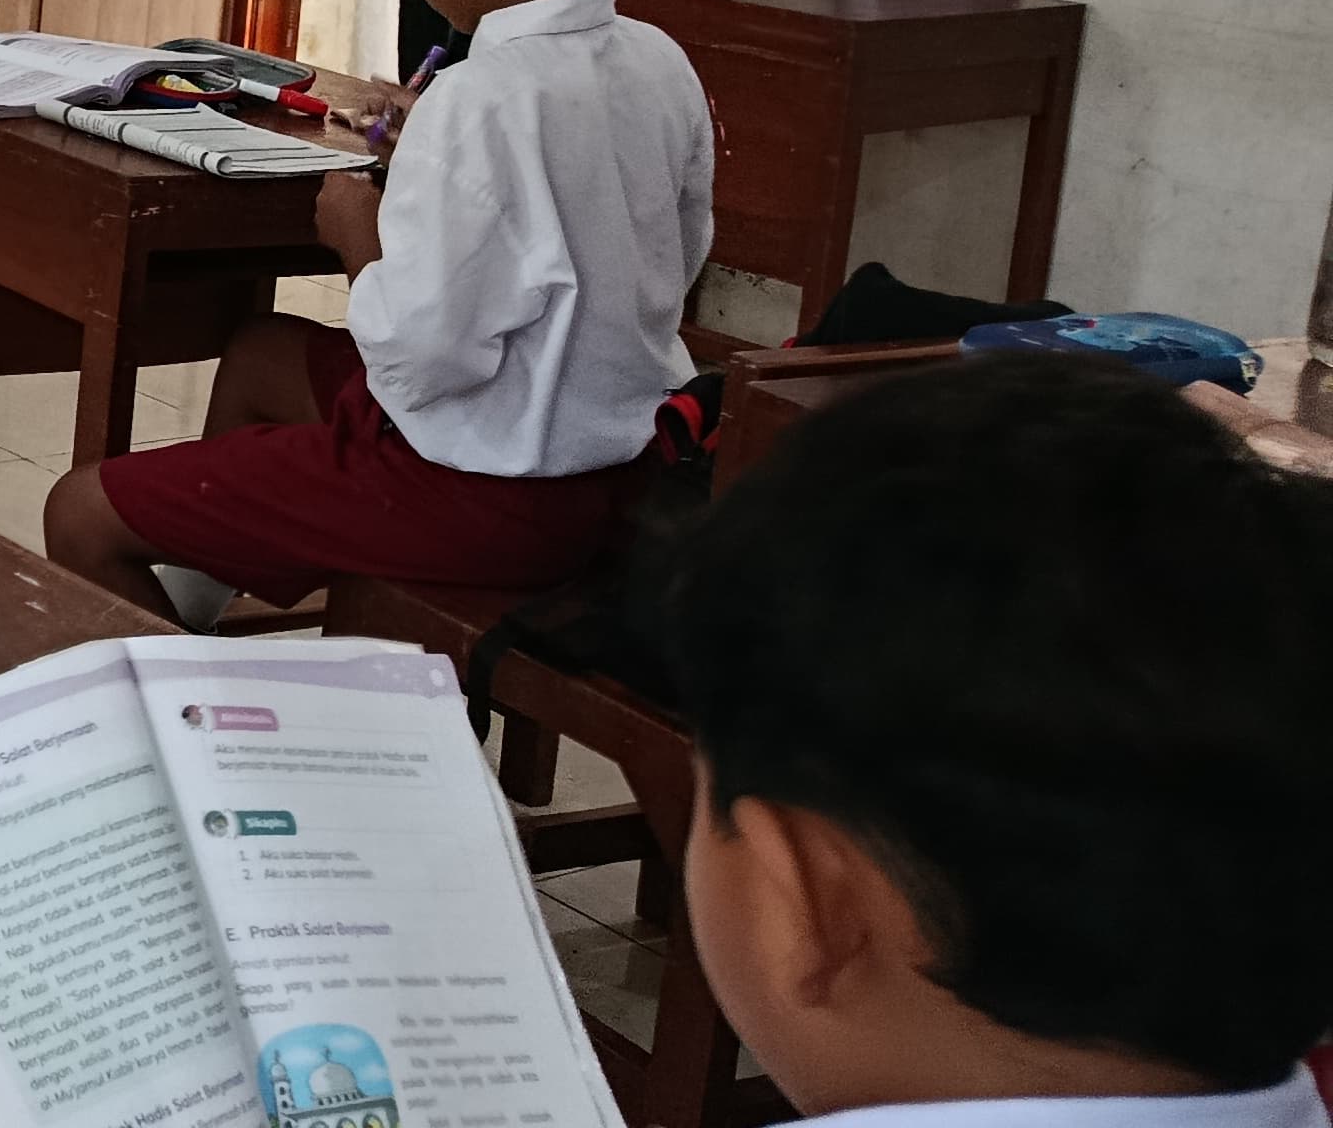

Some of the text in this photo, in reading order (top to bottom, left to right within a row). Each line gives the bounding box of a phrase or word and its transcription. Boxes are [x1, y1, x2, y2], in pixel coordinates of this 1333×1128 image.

[225, 927, 240, 942] E.
[250, 923, 300, 939] Praktik
[302, 922, 335, 937] Salat
[134, 1106, 172, 1127] Hadis
[172, 1091, 204, 1112] Salat
